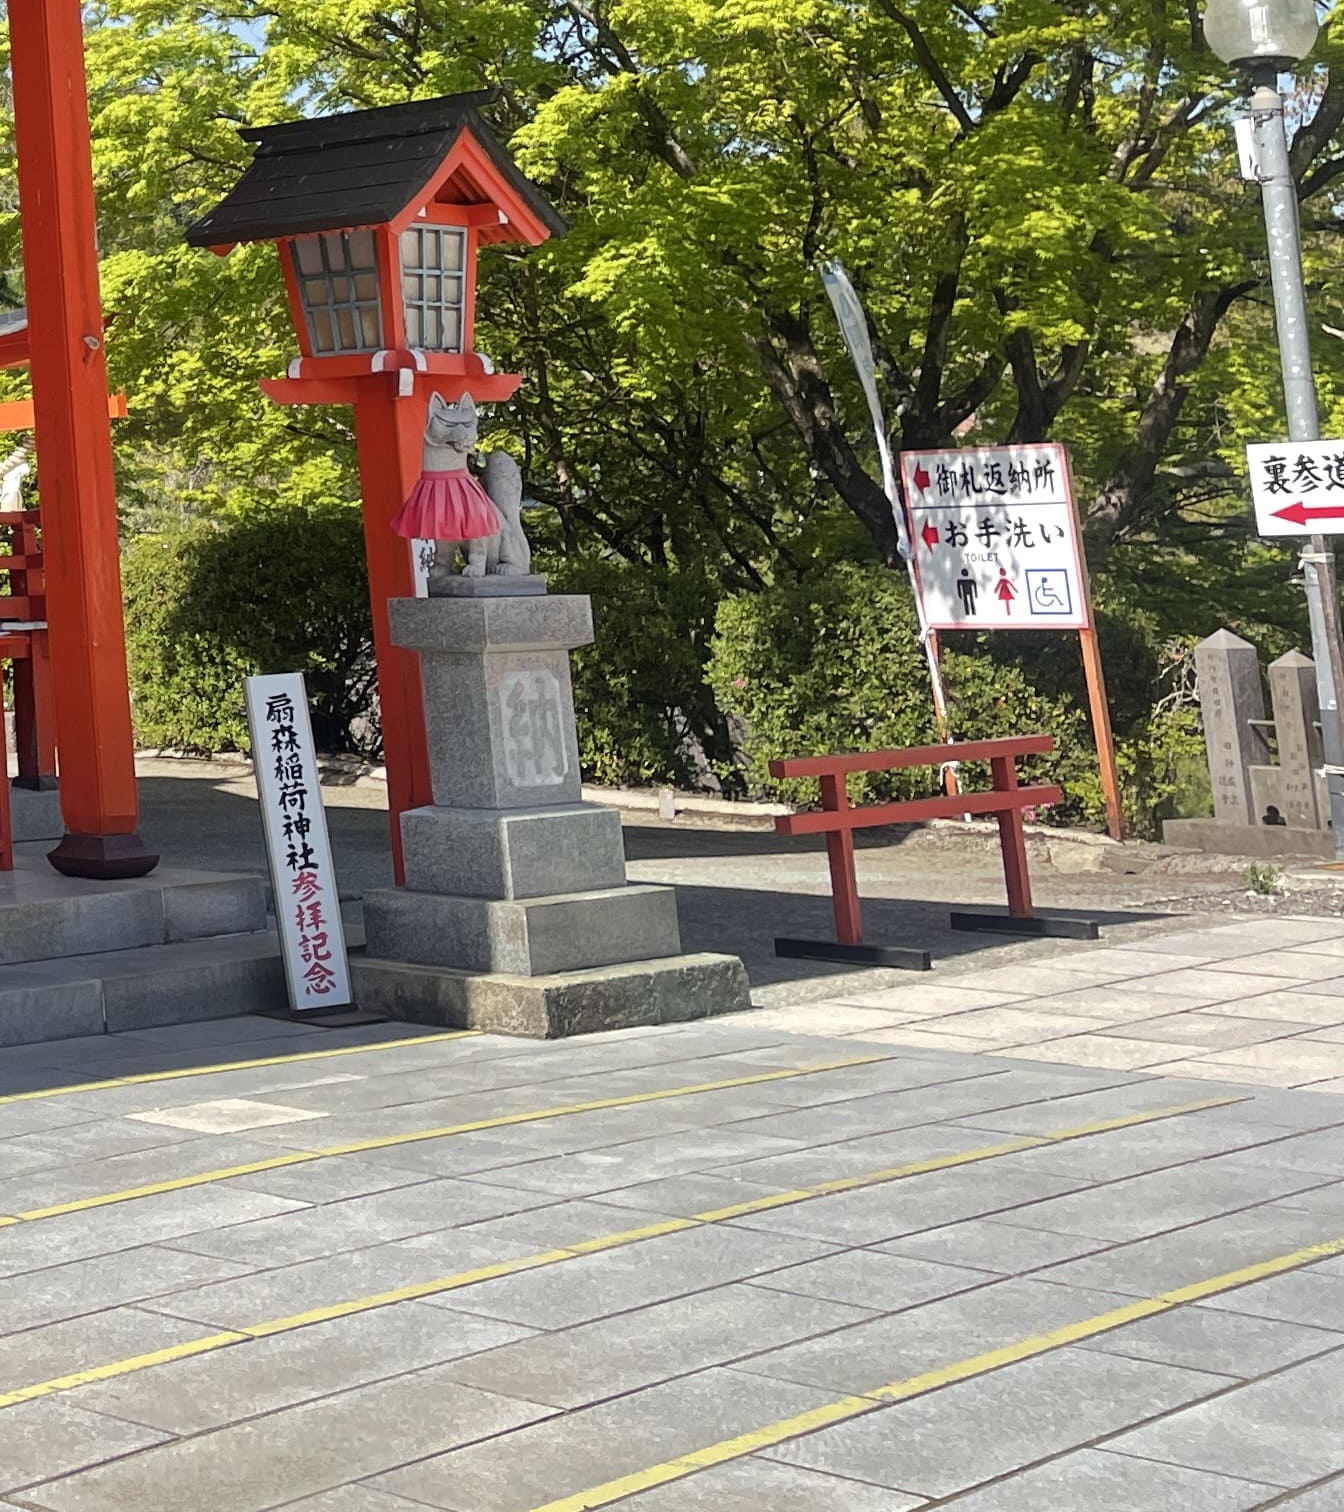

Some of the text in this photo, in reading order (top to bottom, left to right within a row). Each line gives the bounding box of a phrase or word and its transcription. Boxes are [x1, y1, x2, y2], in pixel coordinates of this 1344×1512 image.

[935, 458, 1056, 497] 御札返納所
[944, 516, 1065, 549] お手洗い
[964, 551, 999, 563] TOILET
